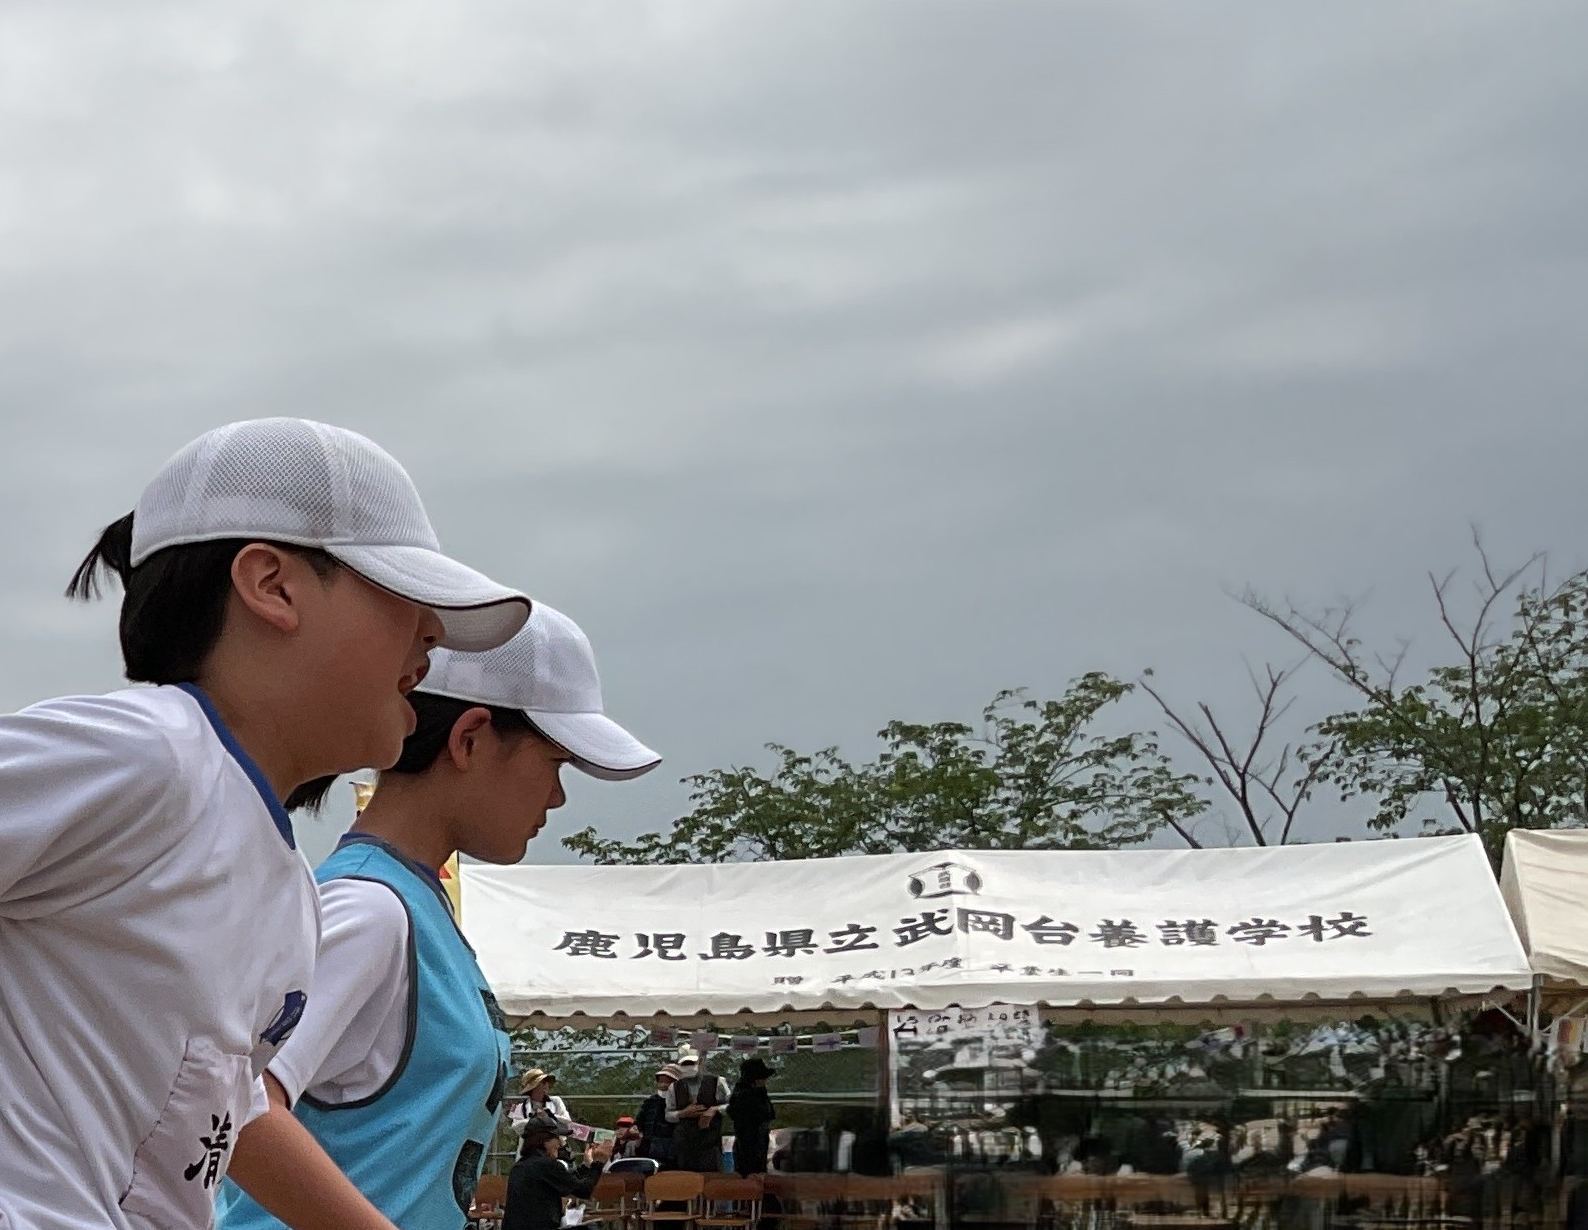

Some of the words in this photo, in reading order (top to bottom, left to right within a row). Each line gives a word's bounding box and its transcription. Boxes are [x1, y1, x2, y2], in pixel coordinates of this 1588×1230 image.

[553, 906, 1374, 962] 鹿児島県立武岡台養護学校
